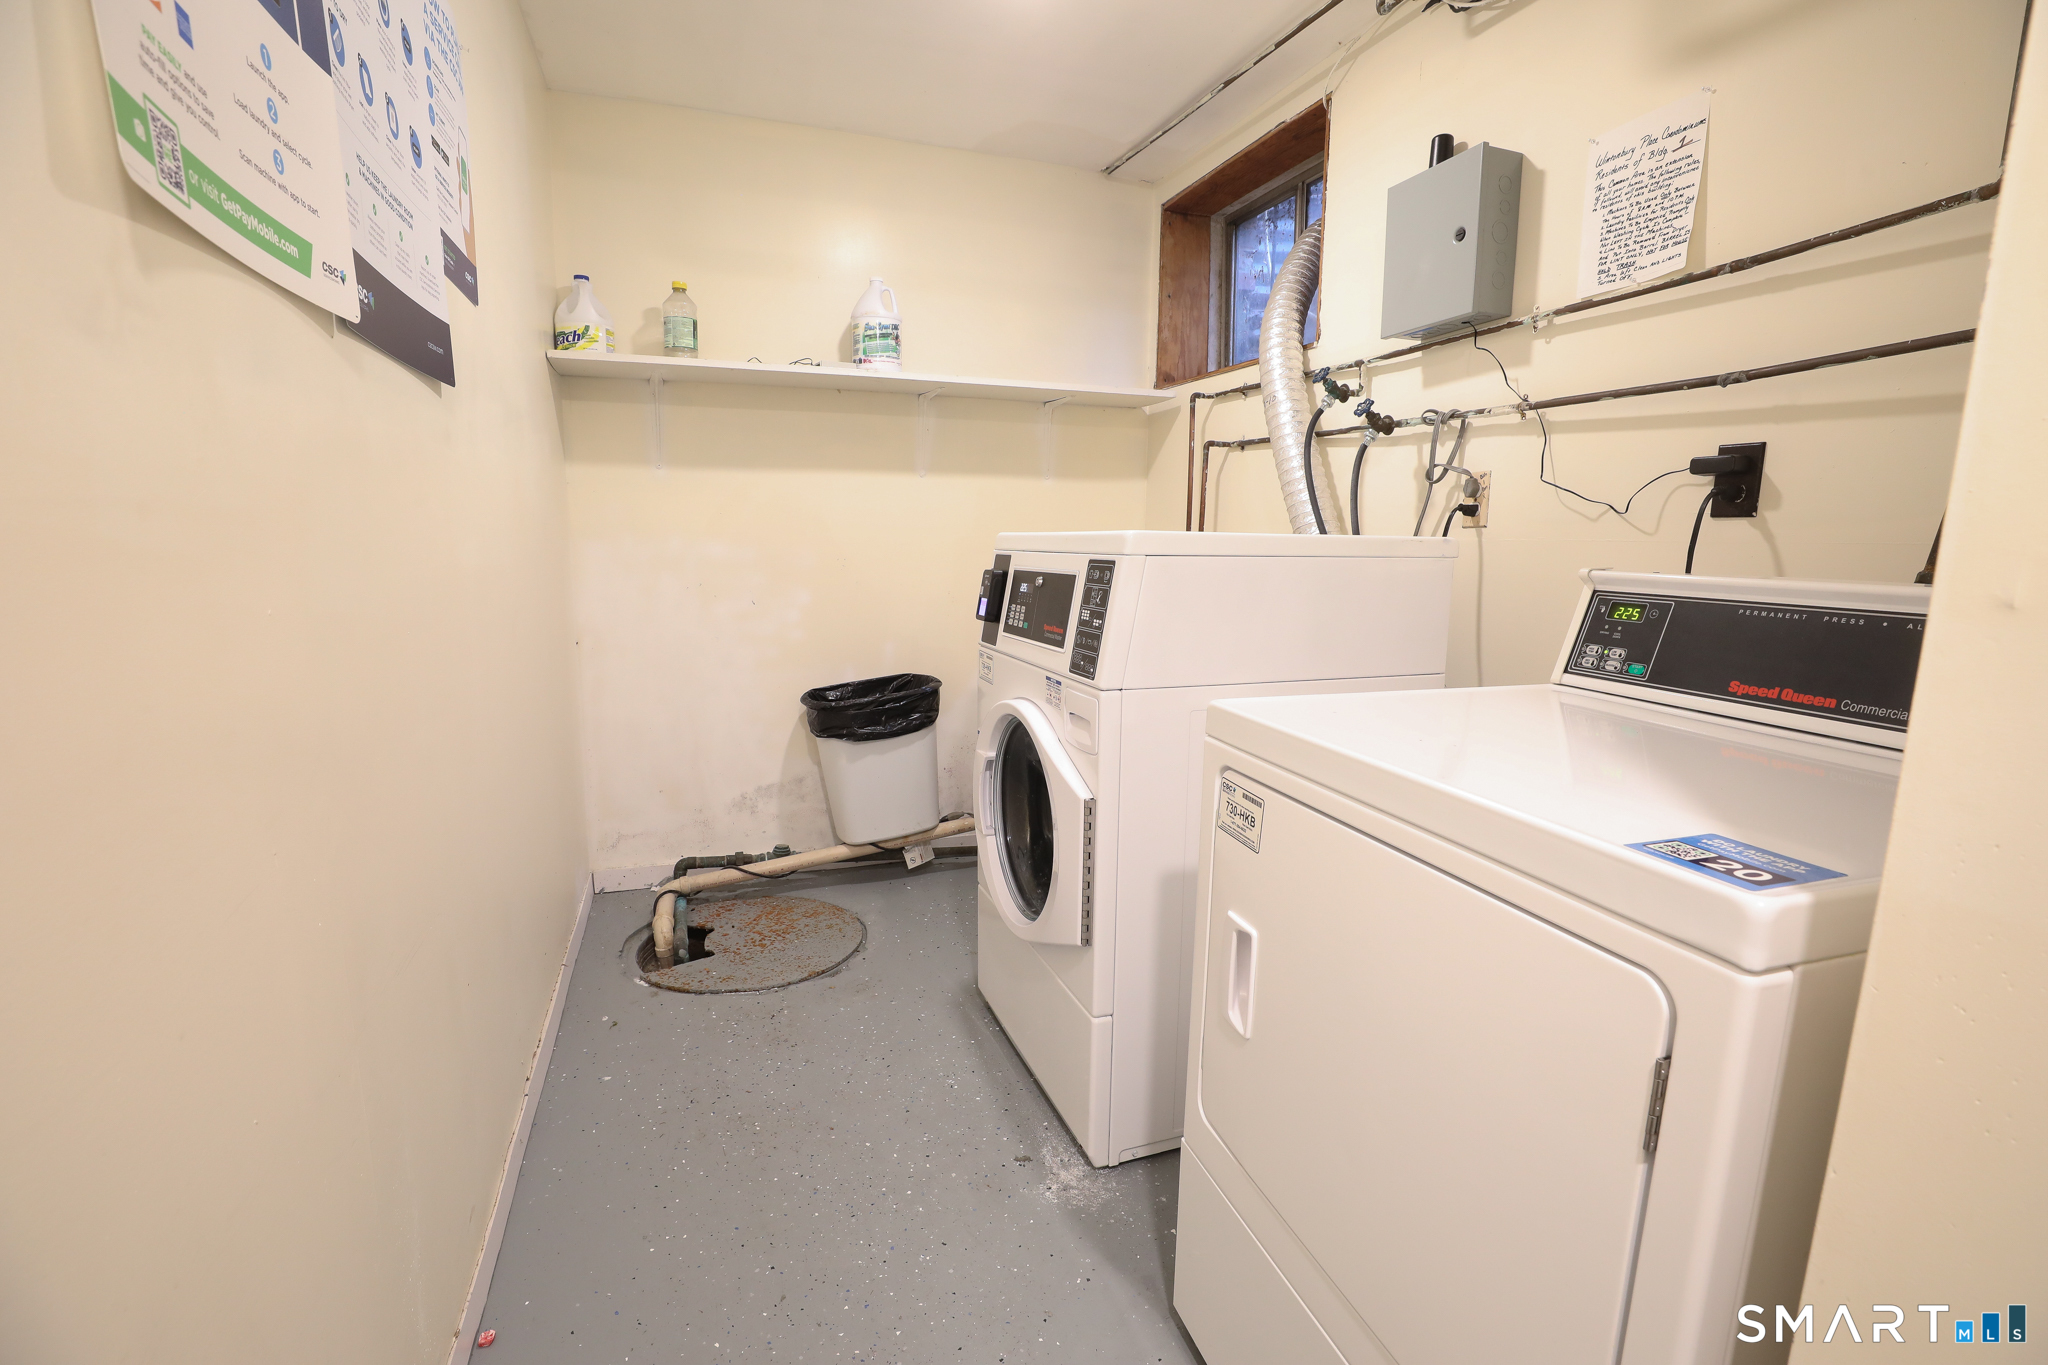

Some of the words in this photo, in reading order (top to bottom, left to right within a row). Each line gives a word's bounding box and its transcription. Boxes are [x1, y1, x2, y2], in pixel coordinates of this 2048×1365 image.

[156, 73, 169, 92] and
[170, 87, 184, 107] give
[183, 69, 196, 88] and
[196, 82, 208, 100] use
[246, 55, 267, 83] Launch
[267, 77, 277, 93] the
[277, 89, 289, 105] app.
[168, 69, 192, 99] options
[200, 102, 215, 121] save
[233, 92, 248, 114] Load
[248, 106, 270, 135] laundry
[271, 128, 282, 144] and
[282, 139, 298, 157] select
[298, 153, 313, 170] cycle.
[1595, 164, 1629, 181] Residents
[1633, 153, 1646, 171] of
[1630, 170, 1646, 181] Area
[1665, 154, 1693, 168] extension
[239, 148, 254, 168] Scan
[253, 162, 277, 187] machine
[277, 181, 289, 196] with
[289, 190, 300, 205] app
[307, 203, 321, 219] start.
[188, 169, 199, 189] or
[201, 178, 220, 205] visit
[220, 192, 300, 260] GetPayMobile.com
[322, 261, 339, 280] CSC
[358, 284, 368, 303] SC
[1613, 606, 1641, 621] 225
[1738, 608, 1808, 621] PERMANENT
[1823, 615, 1866, 626] PRESS
[1728, 680, 1781, 699] Speed
[1780, 687, 1838, 709] Queen
[1840, 699, 1911, 721] Commercia
[1222, 781, 1233, 792] CSC
[1225, 800, 1257, 829] 730-HKB
[1699, 859, 1773, 881] 20
[1736, 846, 1811, 871] LAUNDRY
[1742, 851, 1772, 863] THE
[1769, 861, 1807, 874] APP
